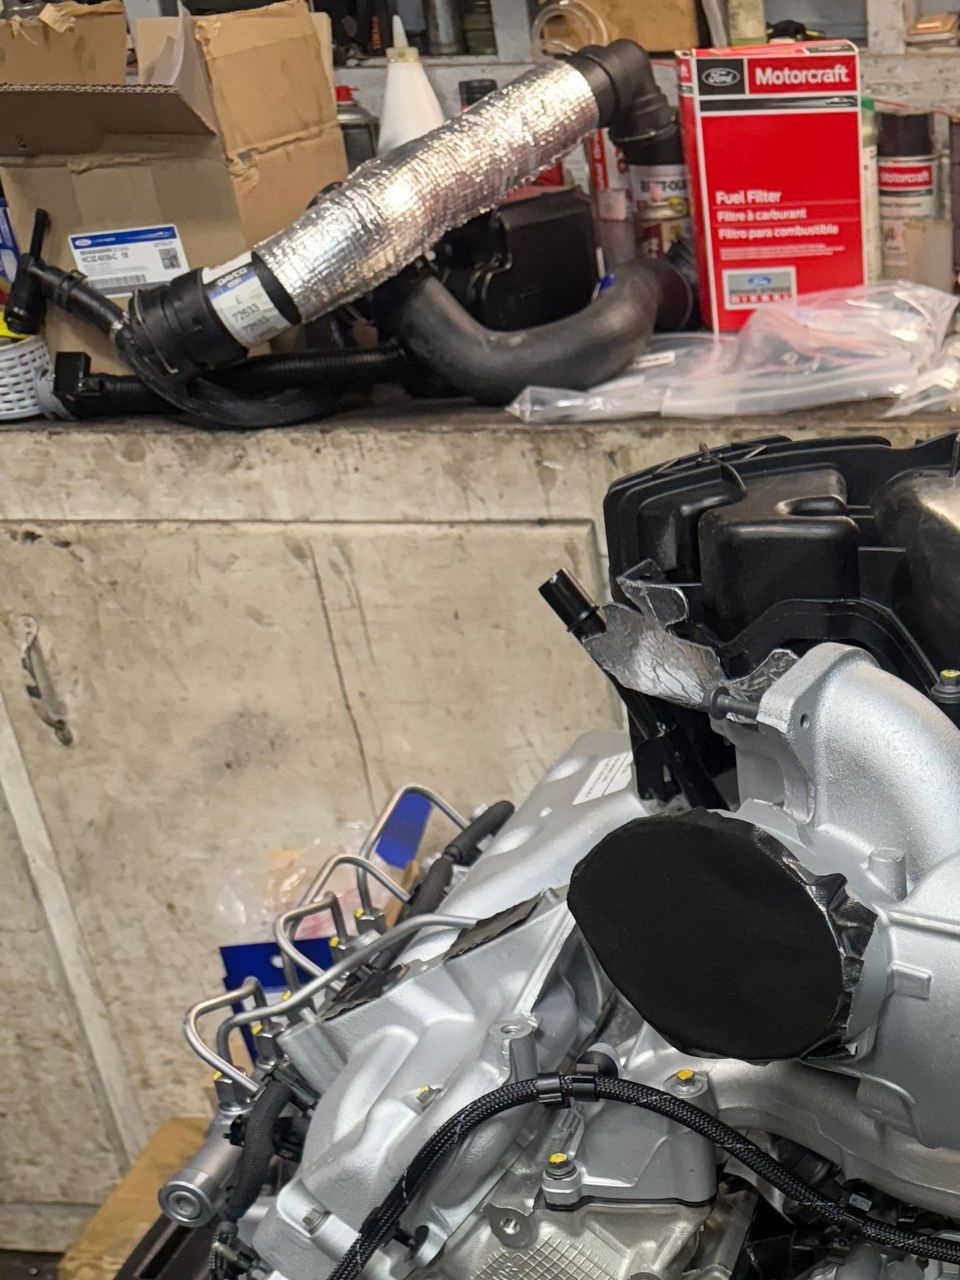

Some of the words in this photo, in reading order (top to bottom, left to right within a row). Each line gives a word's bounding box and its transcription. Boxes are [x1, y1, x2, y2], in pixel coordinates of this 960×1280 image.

[704, 69, 738, 86] Ford
[755, 64, 849, 86] Motorcraft
[715, 191, 745, 205] Fuel
[747, 189, 782, 204] Filter
[717, 210, 746, 222] Filtre
[756, 208, 807, 221] carburant
[718, 227, 747, 240] Filtro
[748, 228, 773, 241] para
[774, 224, 840, 237] combustible
